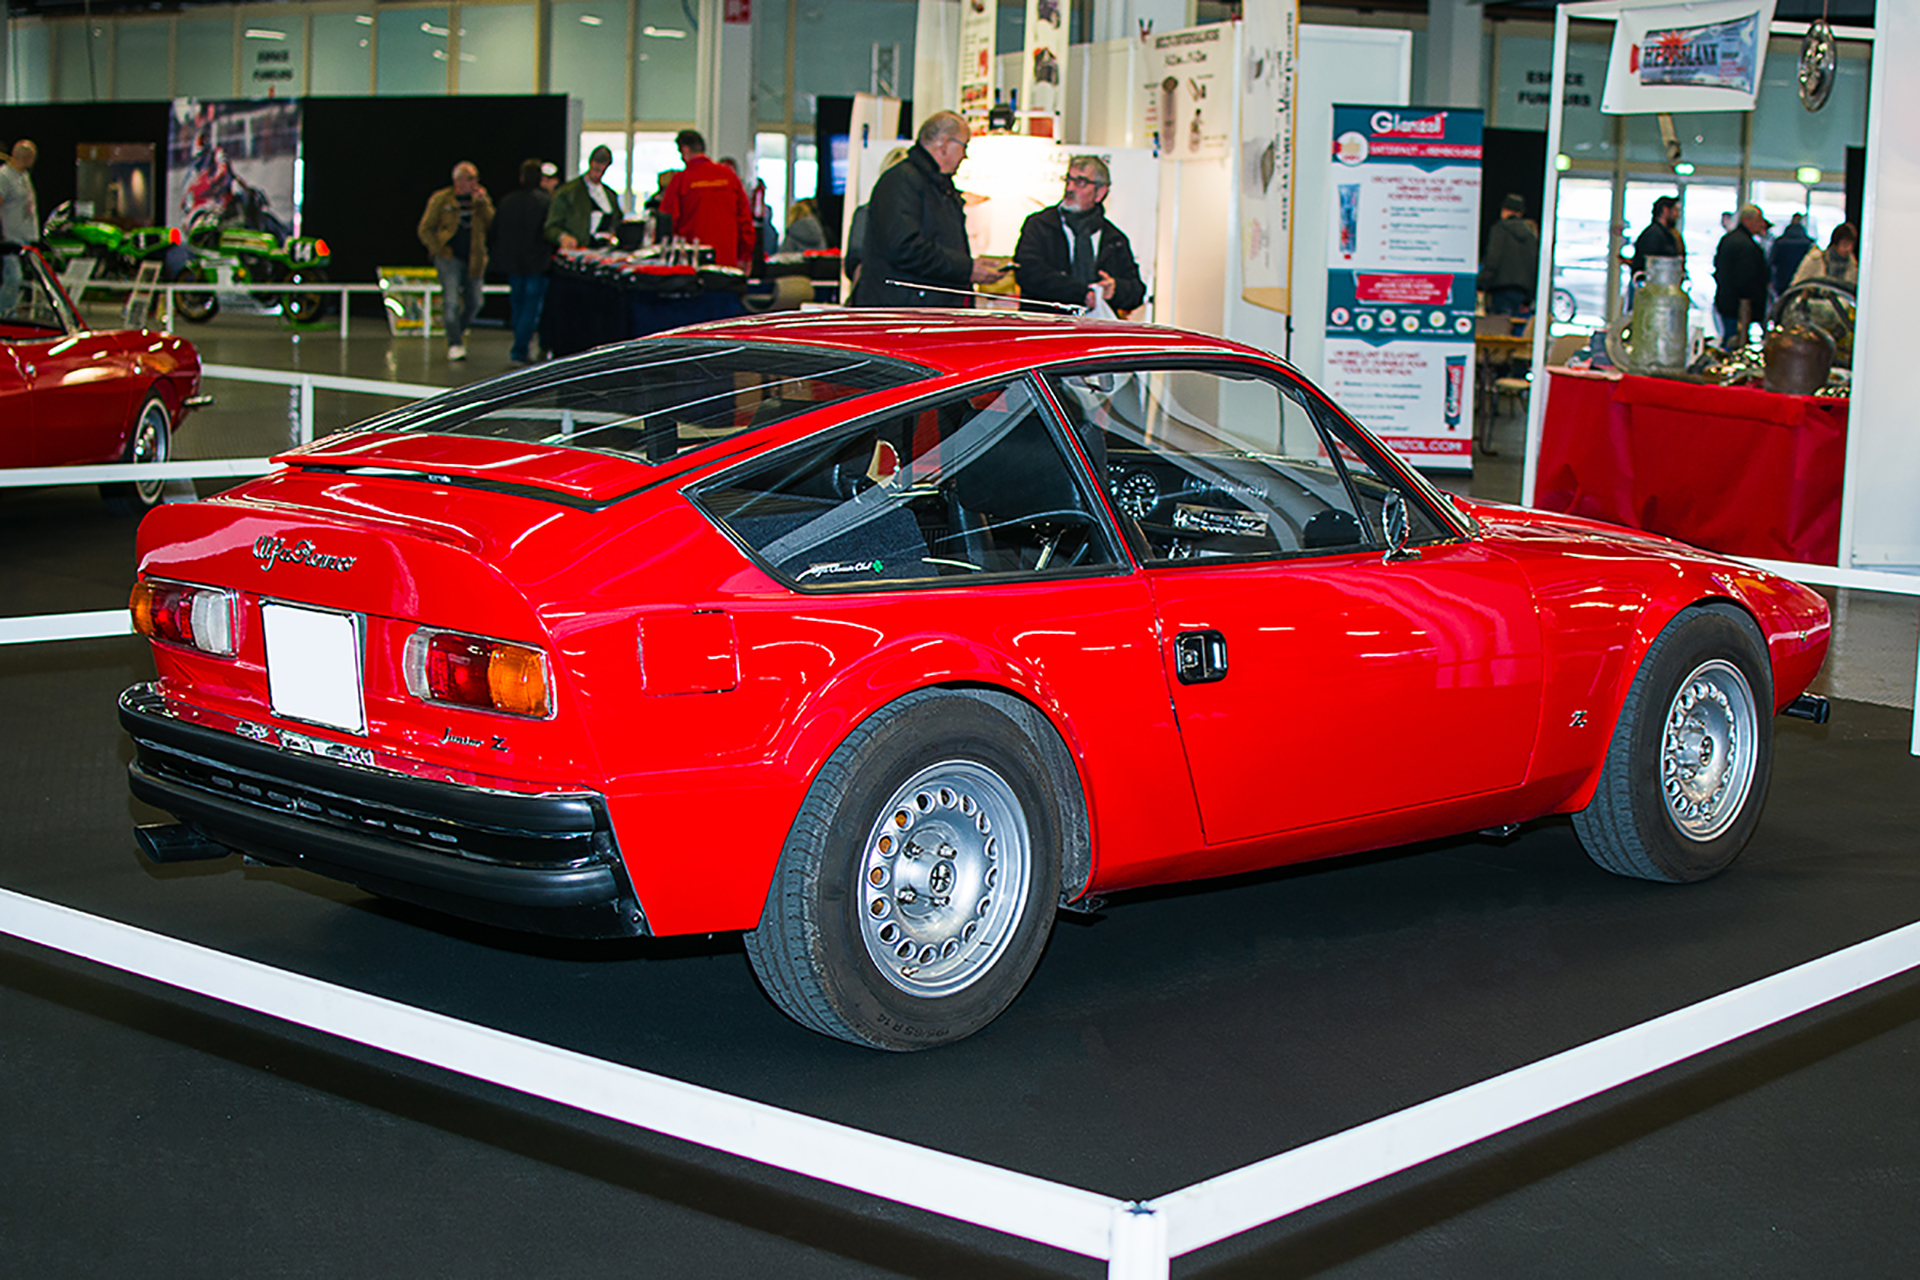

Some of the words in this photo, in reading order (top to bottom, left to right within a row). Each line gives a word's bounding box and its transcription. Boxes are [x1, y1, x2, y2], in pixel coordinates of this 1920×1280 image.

[1526, 71, 1584, 87] ESPCE
[1518, 91, 1591, 107] FUMURS
[1370, 111, 1442, 134] Glanzol
[253, 535, 292, 572] Alfa
[291, 539, 357, 572] Romeo
[438, 727, 484, 747] Junior
[490, 734, 510, 753] Z
